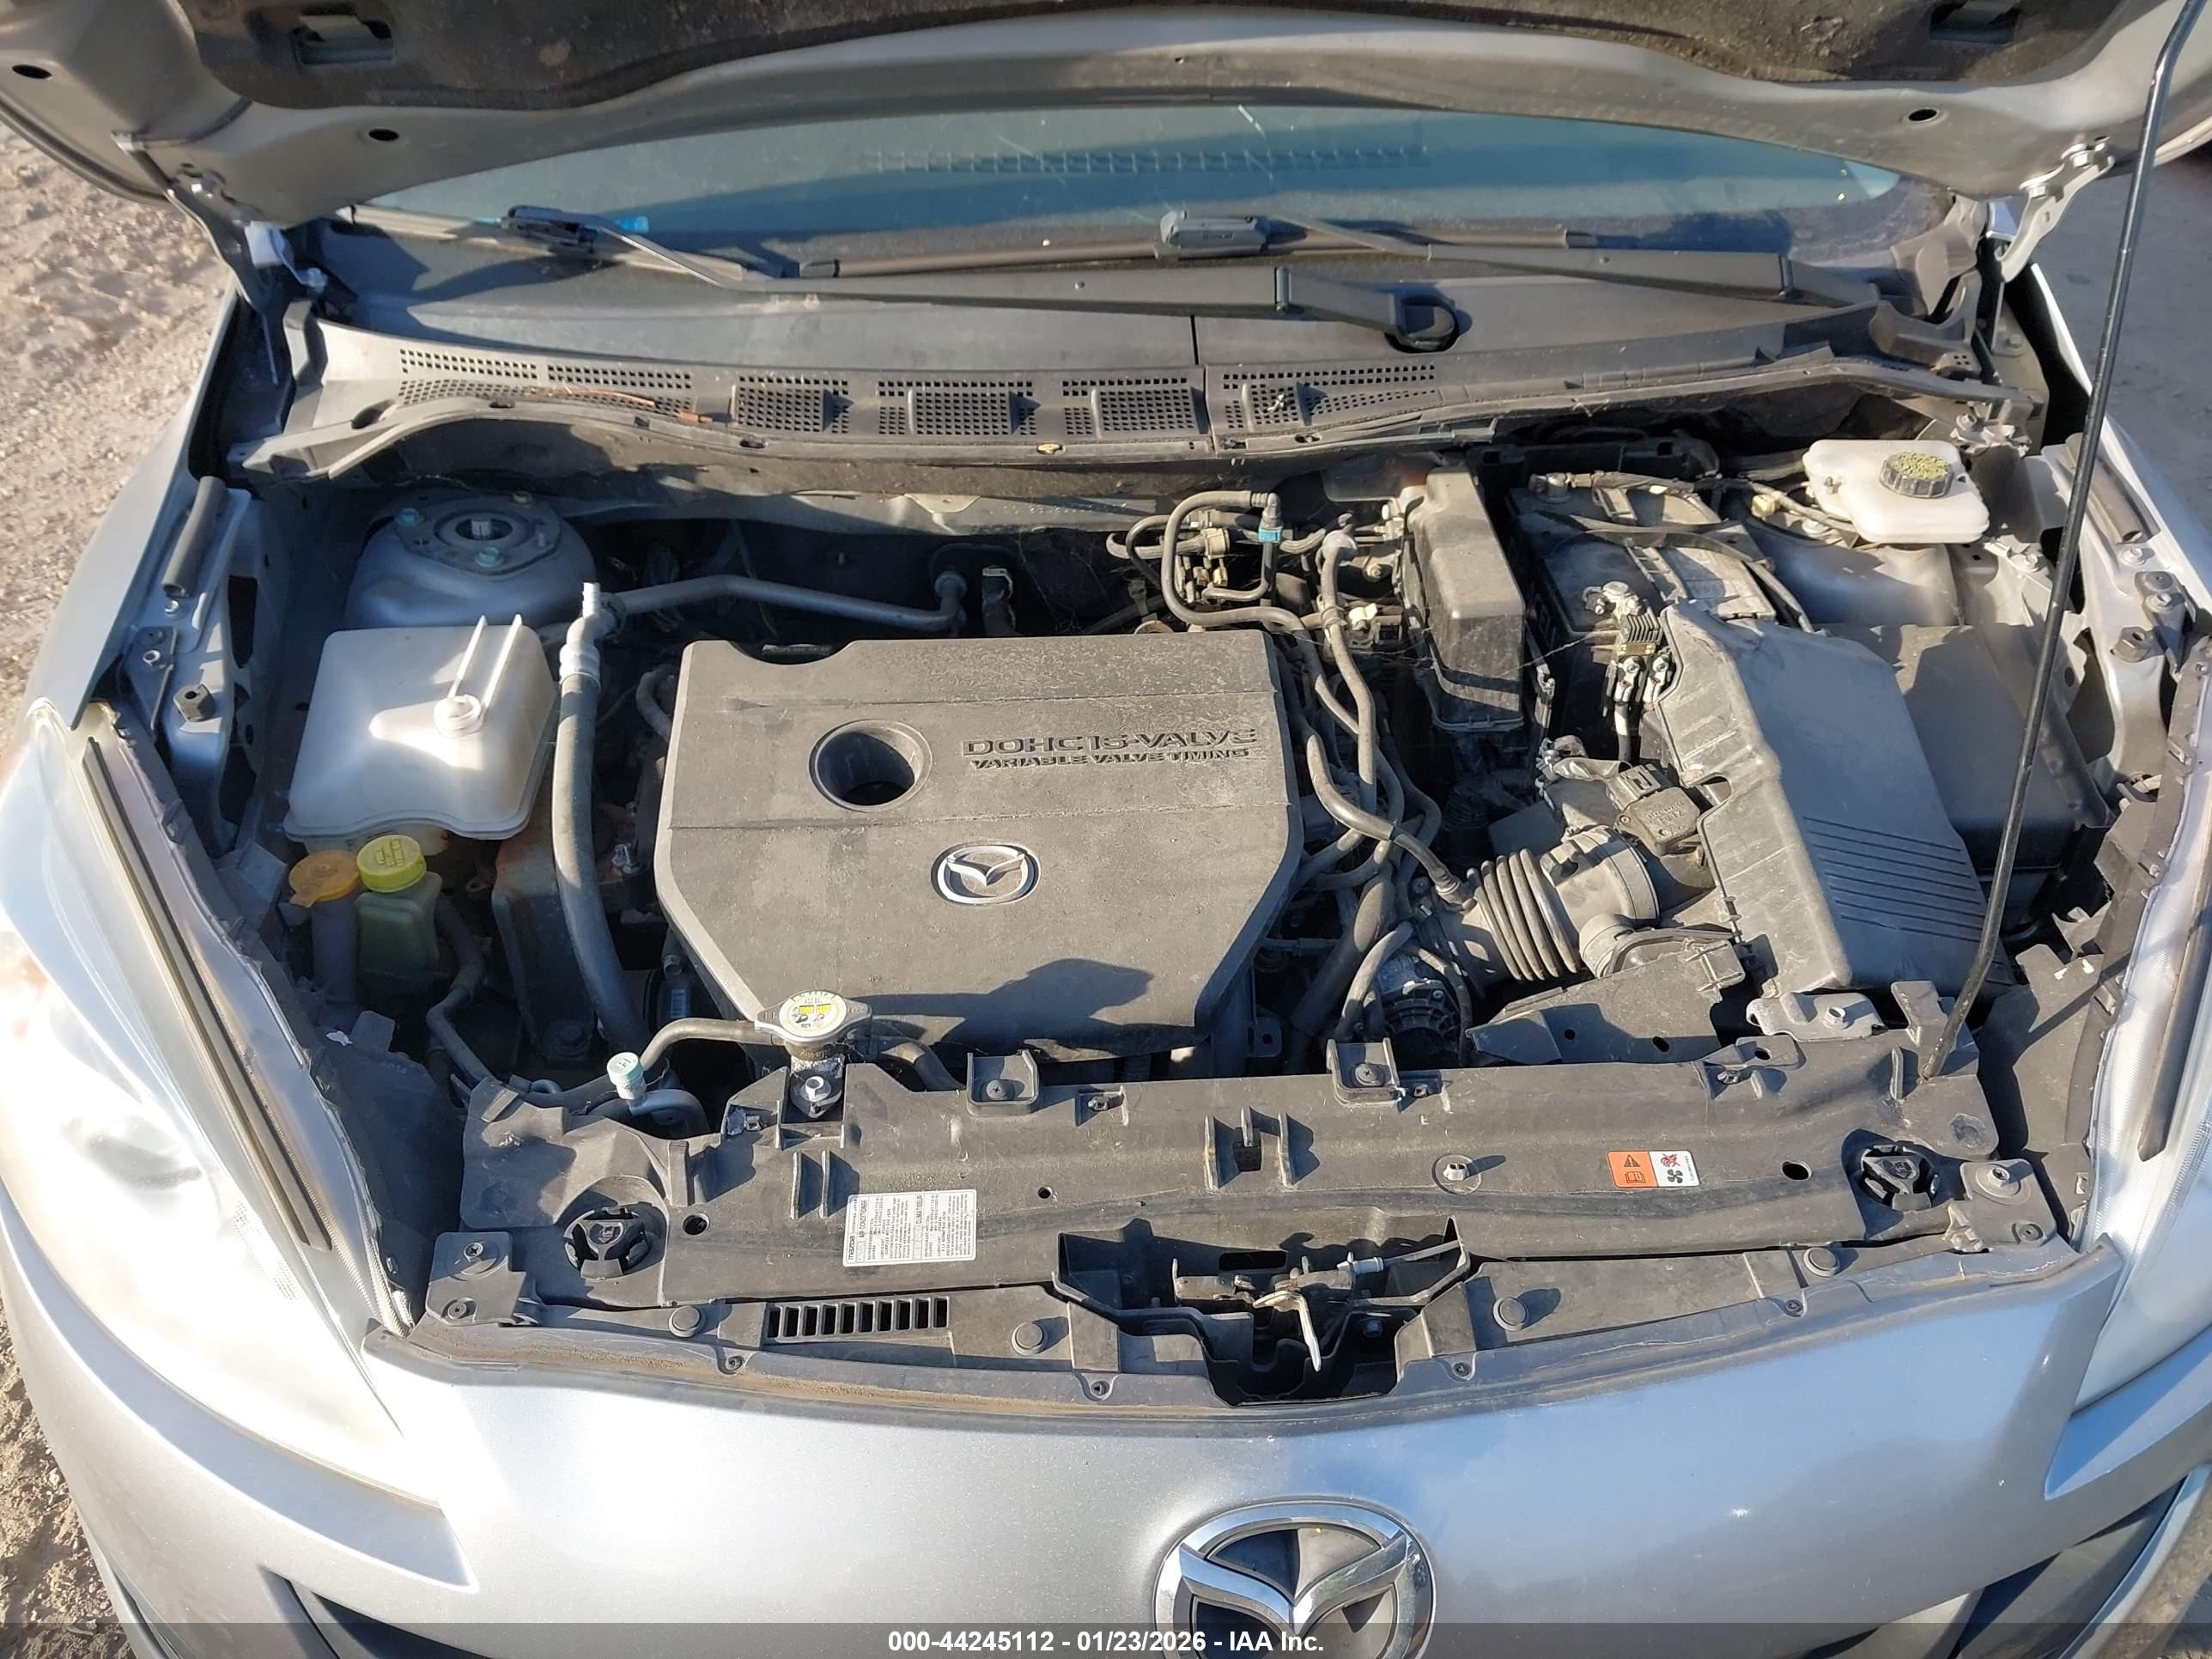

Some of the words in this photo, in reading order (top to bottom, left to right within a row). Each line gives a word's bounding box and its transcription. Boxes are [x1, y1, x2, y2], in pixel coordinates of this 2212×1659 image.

[962, 735, 1084, 757] DOHC
[970, 754, 1089, 769] VARIABLE
[1089, 751, 1165, 764] VALVE
[1166, 747, 1250, 762] TIMING
